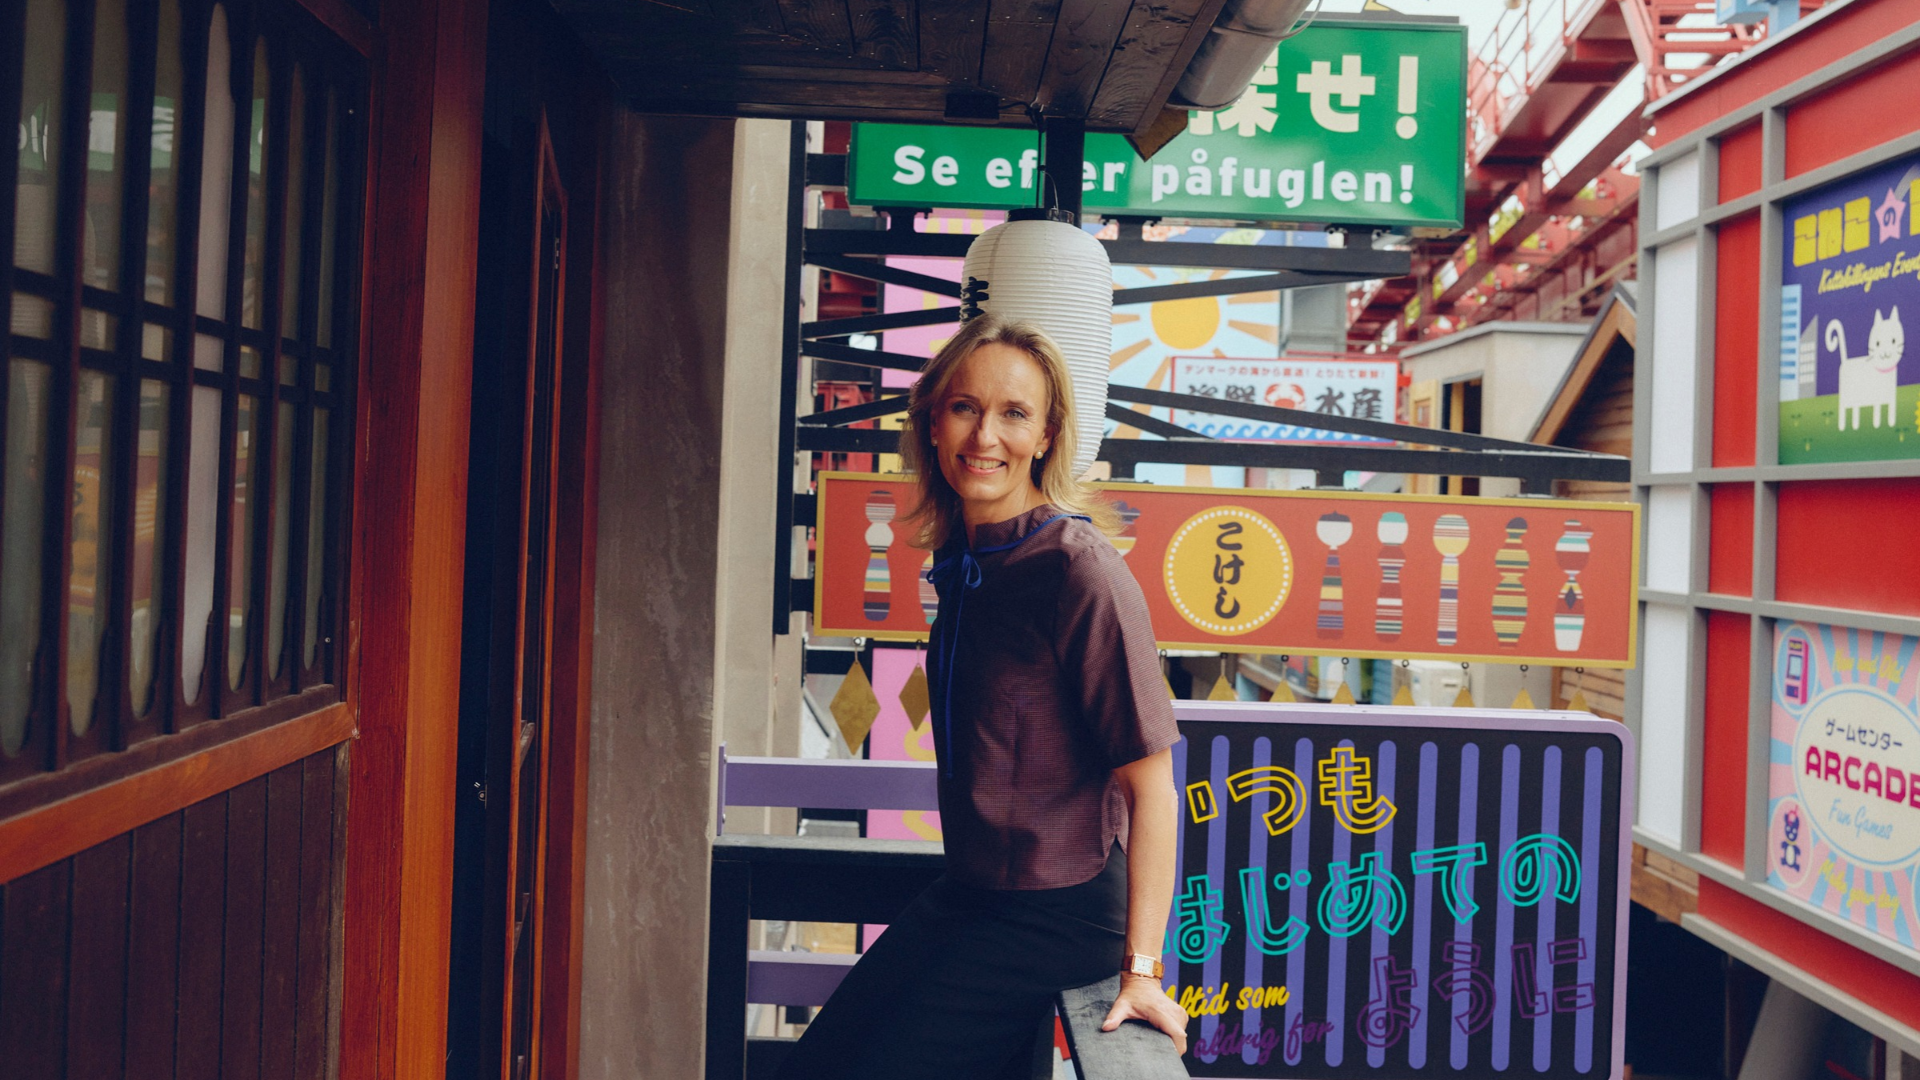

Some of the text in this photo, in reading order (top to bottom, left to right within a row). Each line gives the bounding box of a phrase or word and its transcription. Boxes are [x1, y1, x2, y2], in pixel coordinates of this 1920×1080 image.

[892, 145, 1415, 209] Se efer påfuglen!
[1213, 521, 1245, 619] こけし
[1825, 718, 1903, 751] ゲームセンター
[1805, 745, 1920, 810] ARCADE
[1828, 798, 1893, 840] Fun Games
[1162, 832, 1582, 964] はじめての
[1235, 984, 1290, 1010] som
[1356, 937, 1597, 1049] ように
[1193, 1019, 1281, 1065] aldrig
